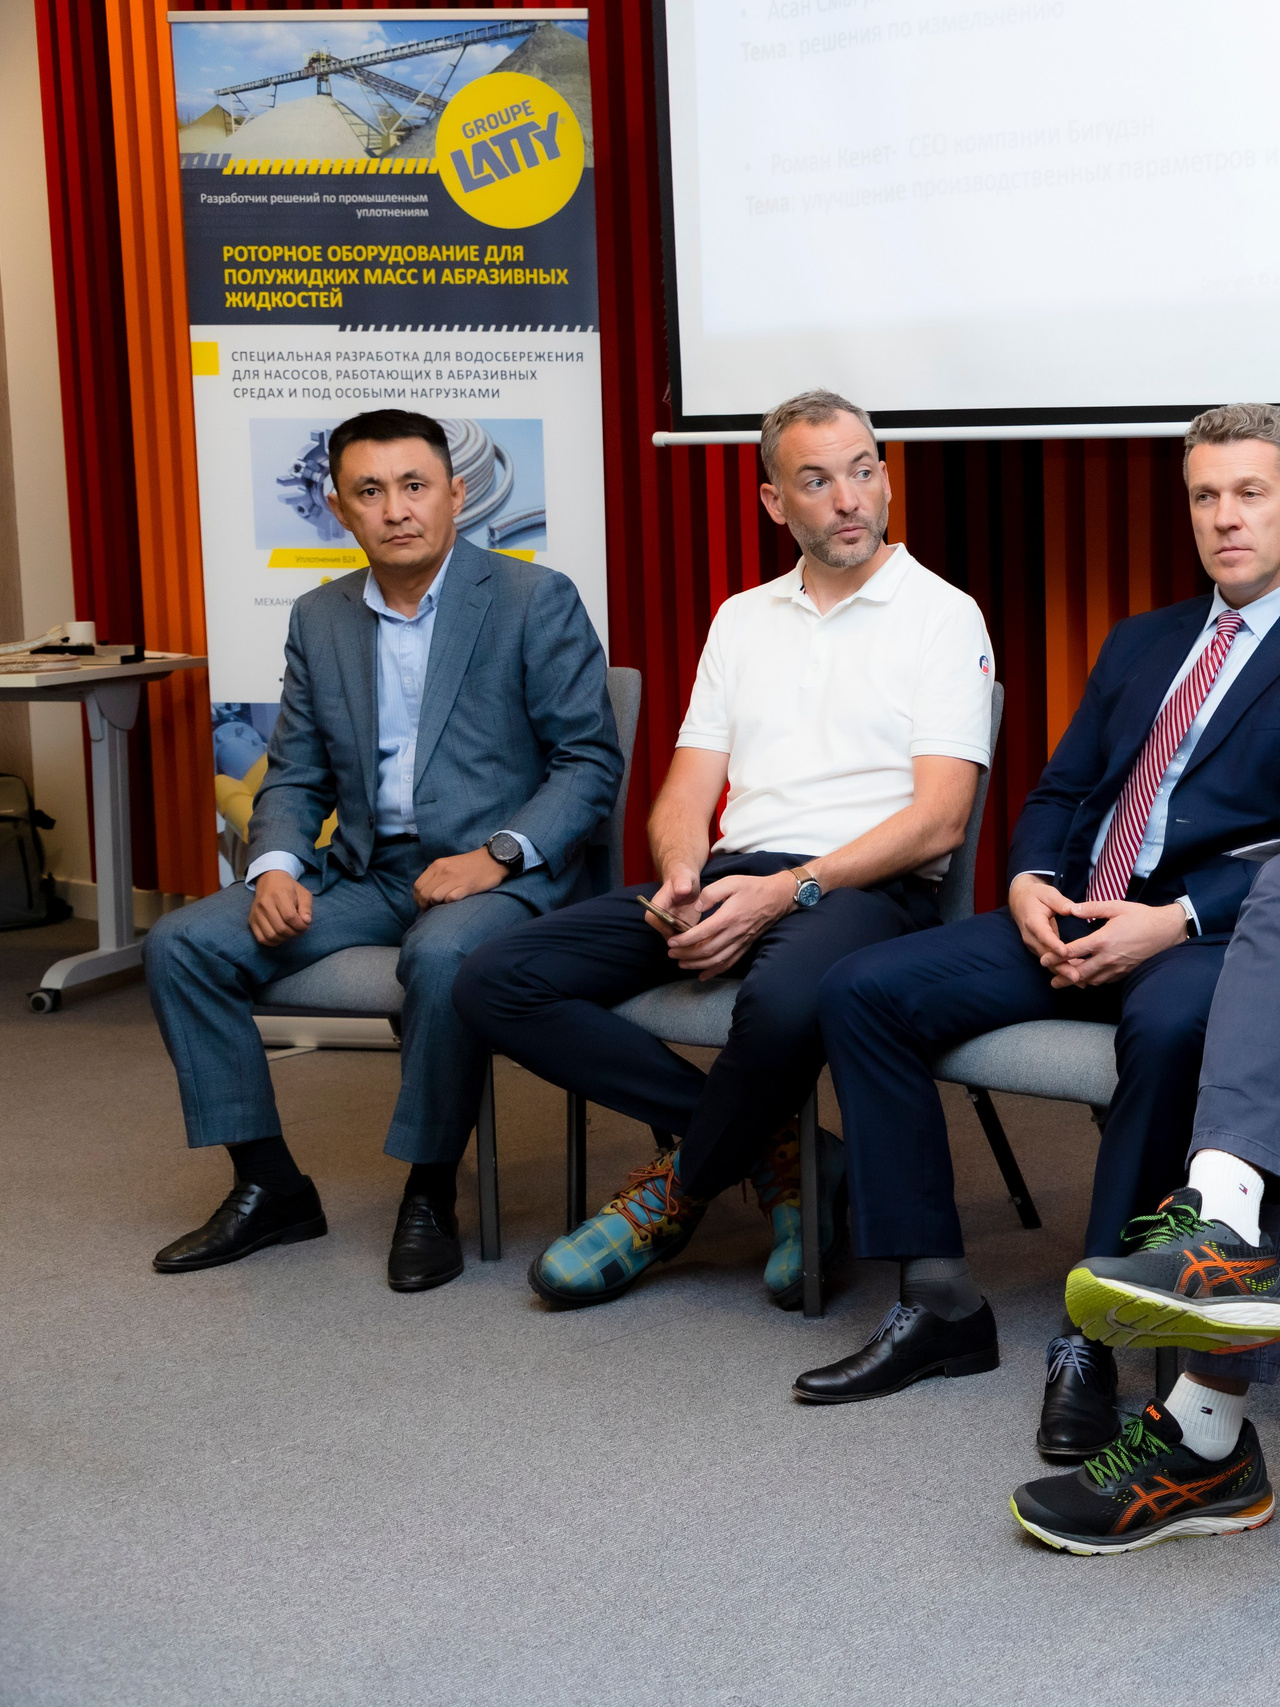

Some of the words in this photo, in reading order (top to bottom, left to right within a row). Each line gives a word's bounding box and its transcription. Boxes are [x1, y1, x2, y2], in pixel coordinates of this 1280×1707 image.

[740, 40, 794, 63] Тема:
[798, 23, 883, 60] решения
[887, 20, 914, 41] по
[917, 1, 1065, 36] измельчению
[462, 99, 535, 139] GROUPE
[450, 111, 561, 194] LATTY
[770, 152, 831, 176] Роман
[953, 124, 1061, 155] компании
[745, 194, 796, 217] Тема:
[800, 182, 907, 214] улучшение
[911, 162, 1113, 201] производственных
[1118, 147, 1257, 182] параметров
[1264, 145, 1279, 166] и
[200, 193, 268, 205] Разработчик
[270, 192, 321, 205] решений
[322, 194, 337, 204] по
[338, 194, 429, 205] промышленным
[355, 207, 429, 219] уплотнениям
[222, 245, 323, 262] РОТОРНОЕ
[327, 245, 480, 265] ОБОРУДОВАНИЕ
[484, 245, 525, 265] ДЛЯ
[224, 268, 360, 288] ПОЛУЖИДКИХ
[363, 268, 418, 285] МАСС
[422, 268, 436, 285] И
[440, 268, 569, 285] АБРАЗИВНЫХ
[225, 287, 343, 311] ЖИДКОСТЕЙ
[231, 351, 332, 363] СПЕЦИАЛЬНАЯ
[335, 351, 420, 362] РАЗРАБОТКА
[424, 351, 451, 364] ДЛЯ
[455, 351, 584, 364] ВОДОСБЕРЕЖЕНИЯ
[232, 369, 260, 382] ДЛЯ
[264, 369, 332, 382] НАСОСОВ,
[335, 369, 432, 381] РАБОТАЮЩИХ
[435, 370, 443, 380] В
[447, 370, 537, 380] АБРАЗИВНЫХ
[233, 387, 284, 400] СРЕДАХ
[288, 388, 298, 398] И
[302, 388, 332, 400] ПОД
[335, 387, 406, 398] ОСОБЫМИ
[410, 388, 500, 399] НАГРУЗКАМИ
[295, 555, 341, 563] Уплотнения
